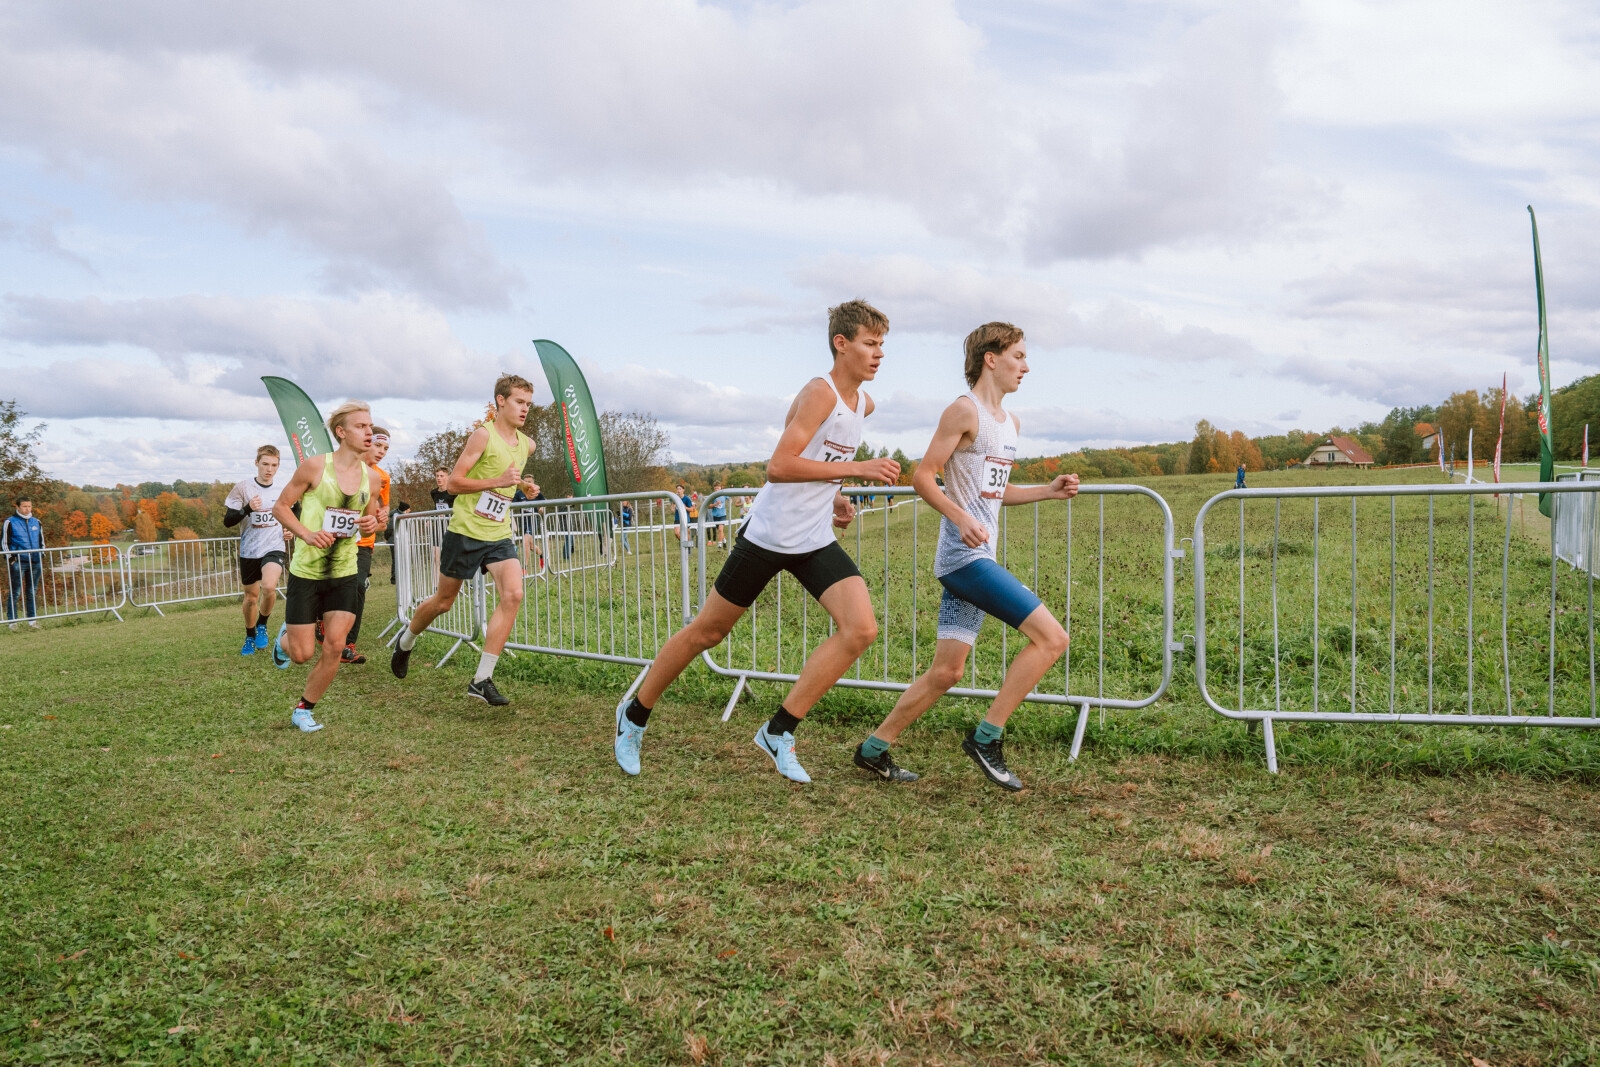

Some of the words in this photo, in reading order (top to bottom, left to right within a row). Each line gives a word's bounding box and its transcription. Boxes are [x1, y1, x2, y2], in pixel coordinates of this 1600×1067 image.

[988, 467, 1008, 488] 332
[486, 497, 505, 514] 115
[255, 512, 275, 523] 302
[330, 514, 356, 530] 199
